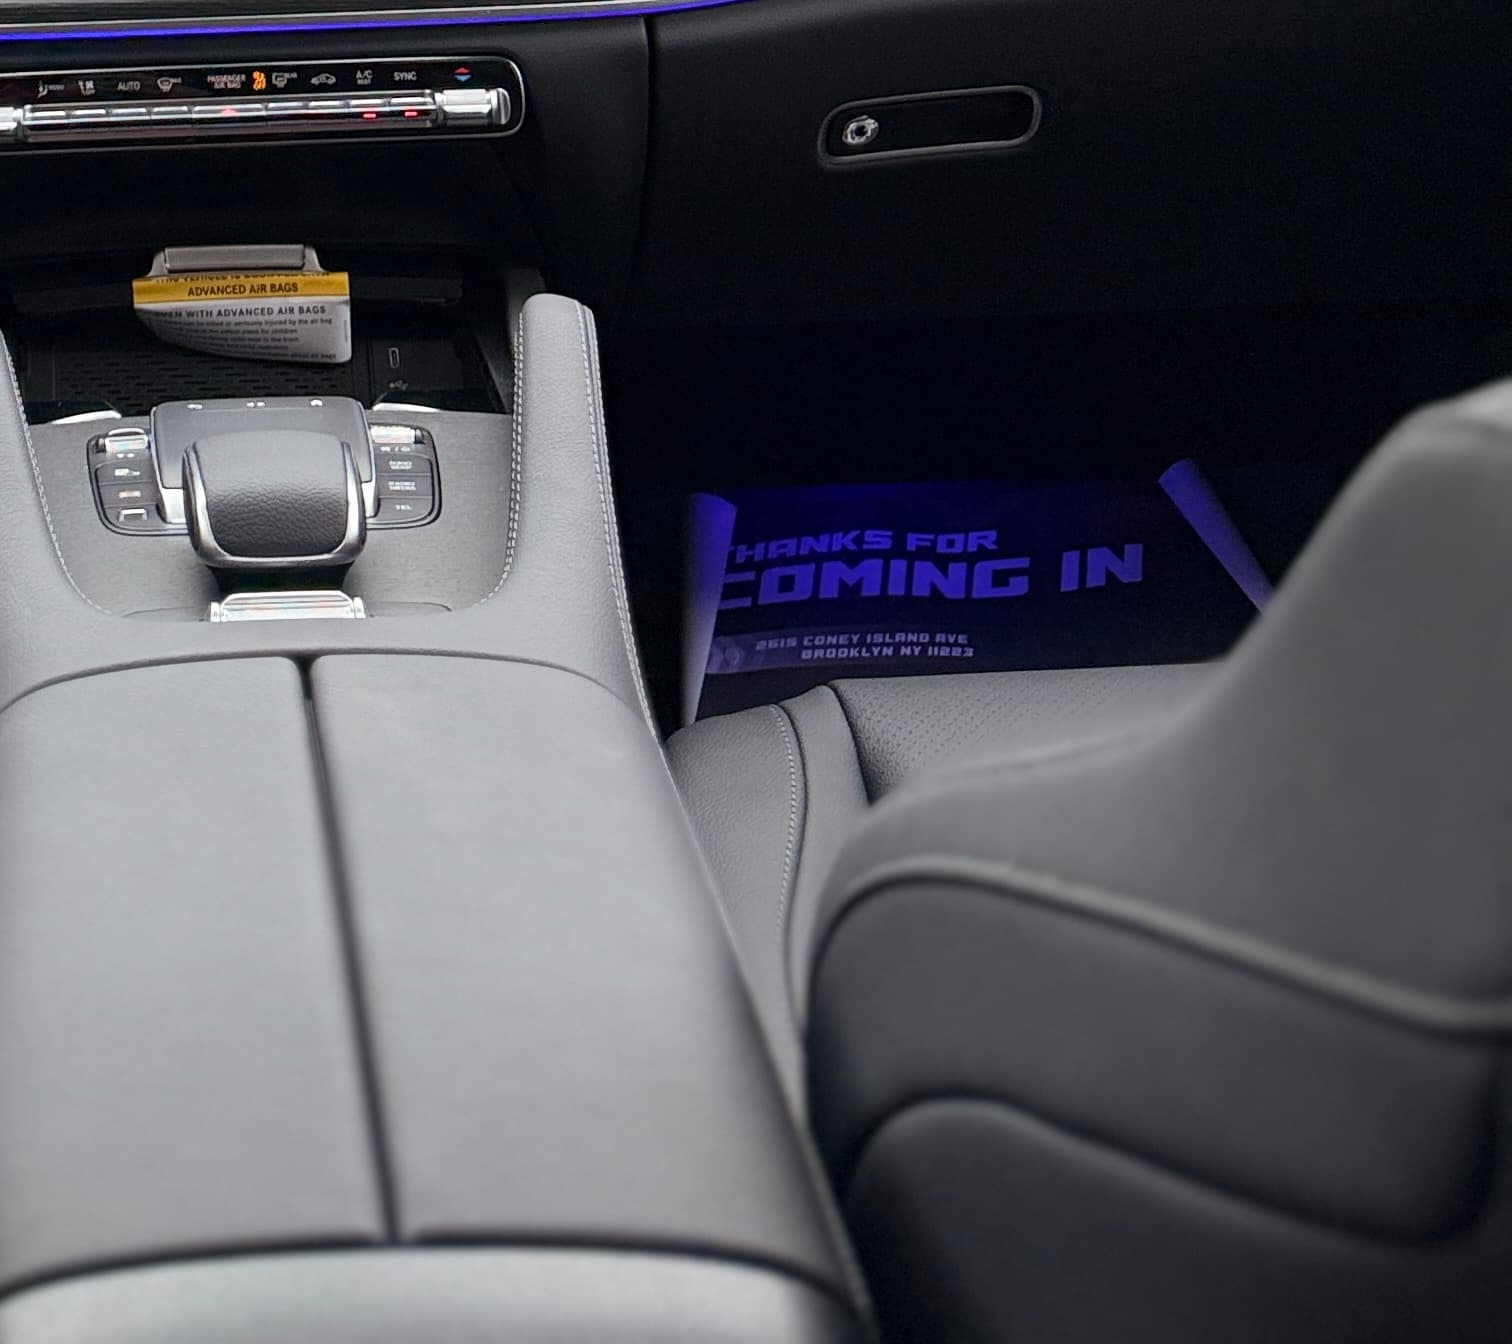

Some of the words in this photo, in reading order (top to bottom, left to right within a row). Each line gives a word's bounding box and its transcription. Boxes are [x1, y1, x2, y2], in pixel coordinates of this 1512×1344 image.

[355, 70, 373, 79] A/C
[394, 70, 418, 81] SYNC
[117, 80, 141, 91] AUTO
[188, 284, 246, 297] ADVANCED
[249, 283, 267, 293] AIR
[270, 282, 299, 293] BAGS
[187, 309, 212, 318] WITH
[217, 307, 274, 317] ADVANCED
[277, 306, 295, 315] AIR
[299, 305, 326, 314] BAGS
[906, 529, 999, 555] FOR
[1059, 543, 1144, 593] IN
[803, 633, 861, 646] CONEY
[867, 632, 930, 643] ISLAND
[935, 633, 968, 644] AVE
[801, 646, 894, 659] BROOKLYN
[900, 645, 921, 656] NY
